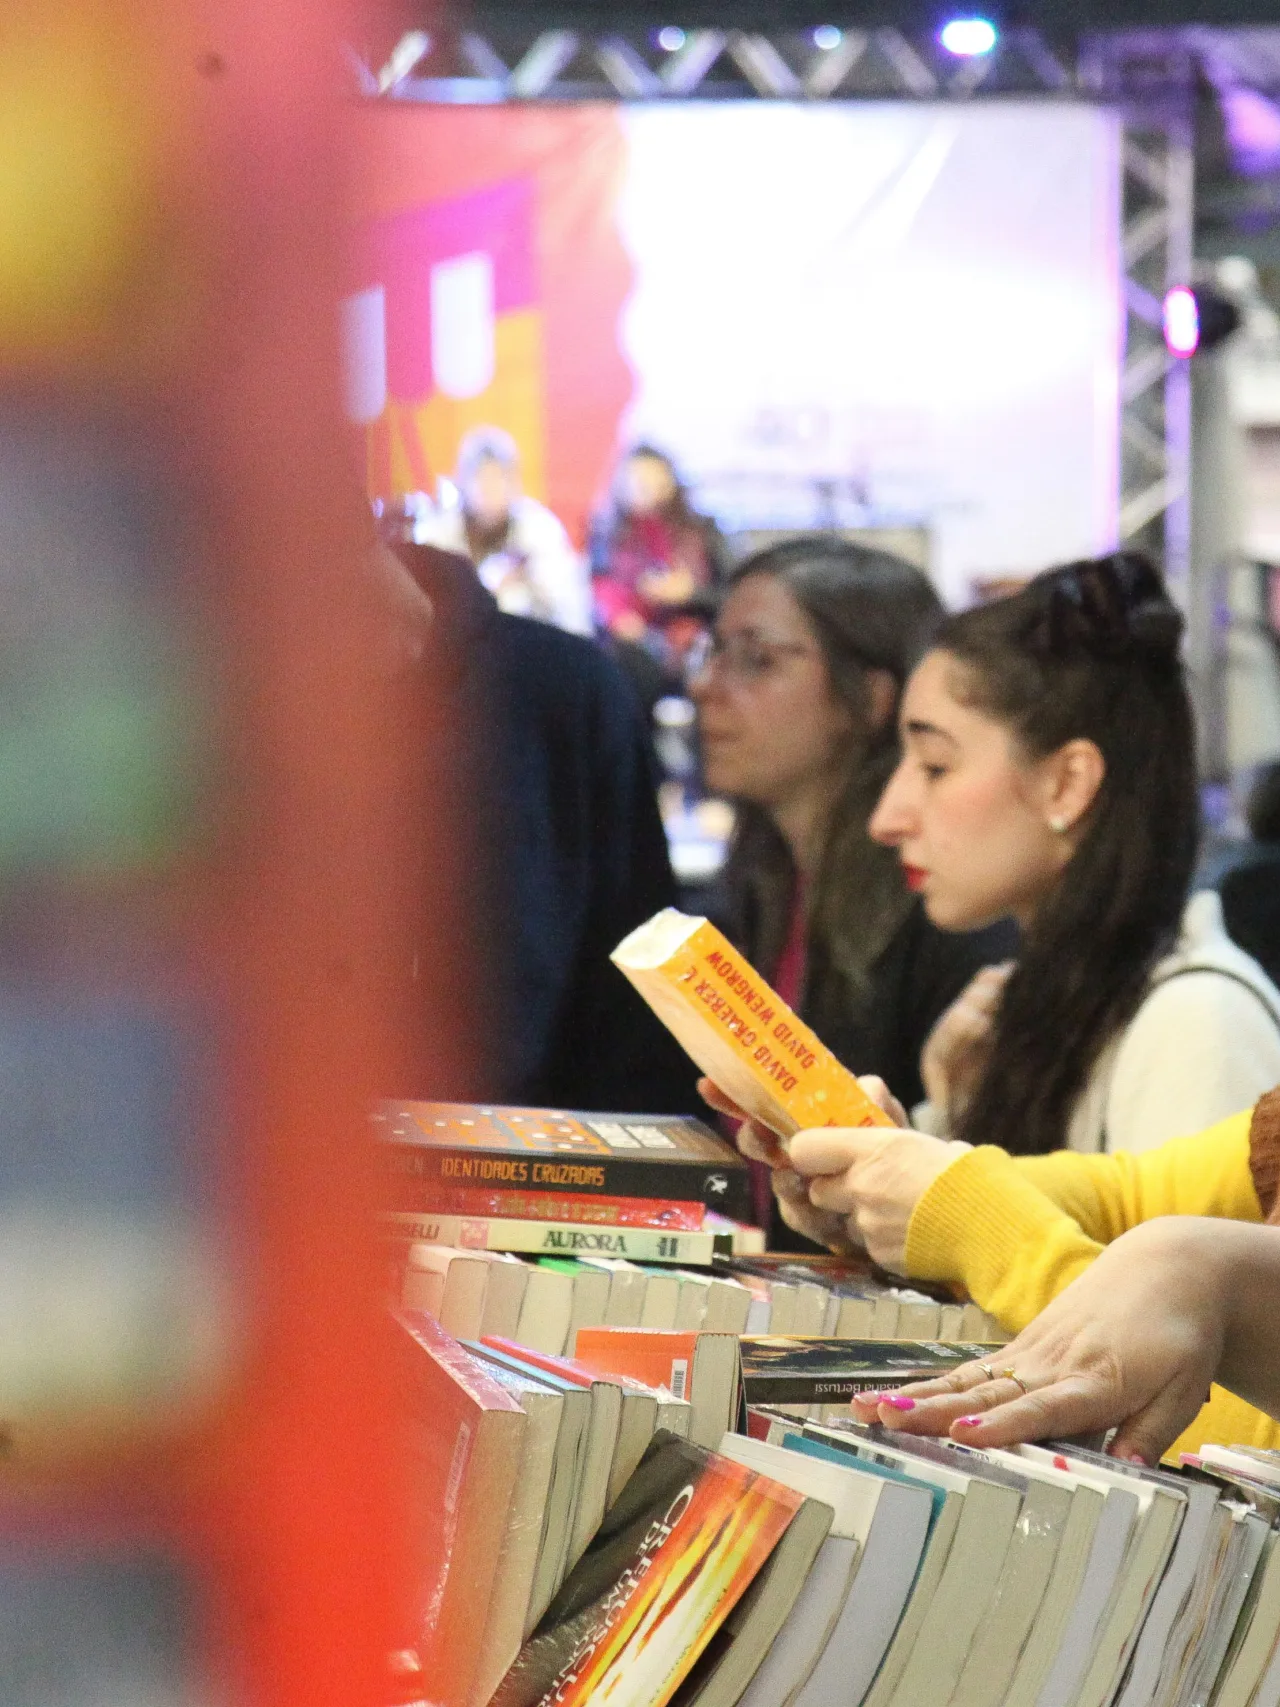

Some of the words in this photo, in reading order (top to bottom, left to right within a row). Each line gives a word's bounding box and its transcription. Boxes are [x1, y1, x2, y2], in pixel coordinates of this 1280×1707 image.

[706, 951, 775, 1026] WENGROW
[694, 979, 757, 1048] GRAEBER
[773, 1022, 816, 1069] DAVID
[754, 1046, 798, 1092] DAVID
[441, 1157, 527, 1182] IDENTIDADES
[532, 1164, 606, 1186] CRUZADAS
[542, 1229, 628, 1253] AURORA
[814, 1383, 861, 1394] Bertussi
[635, 1521, 660, 1557] DE
[602, 1569, 632, 1610] UM
